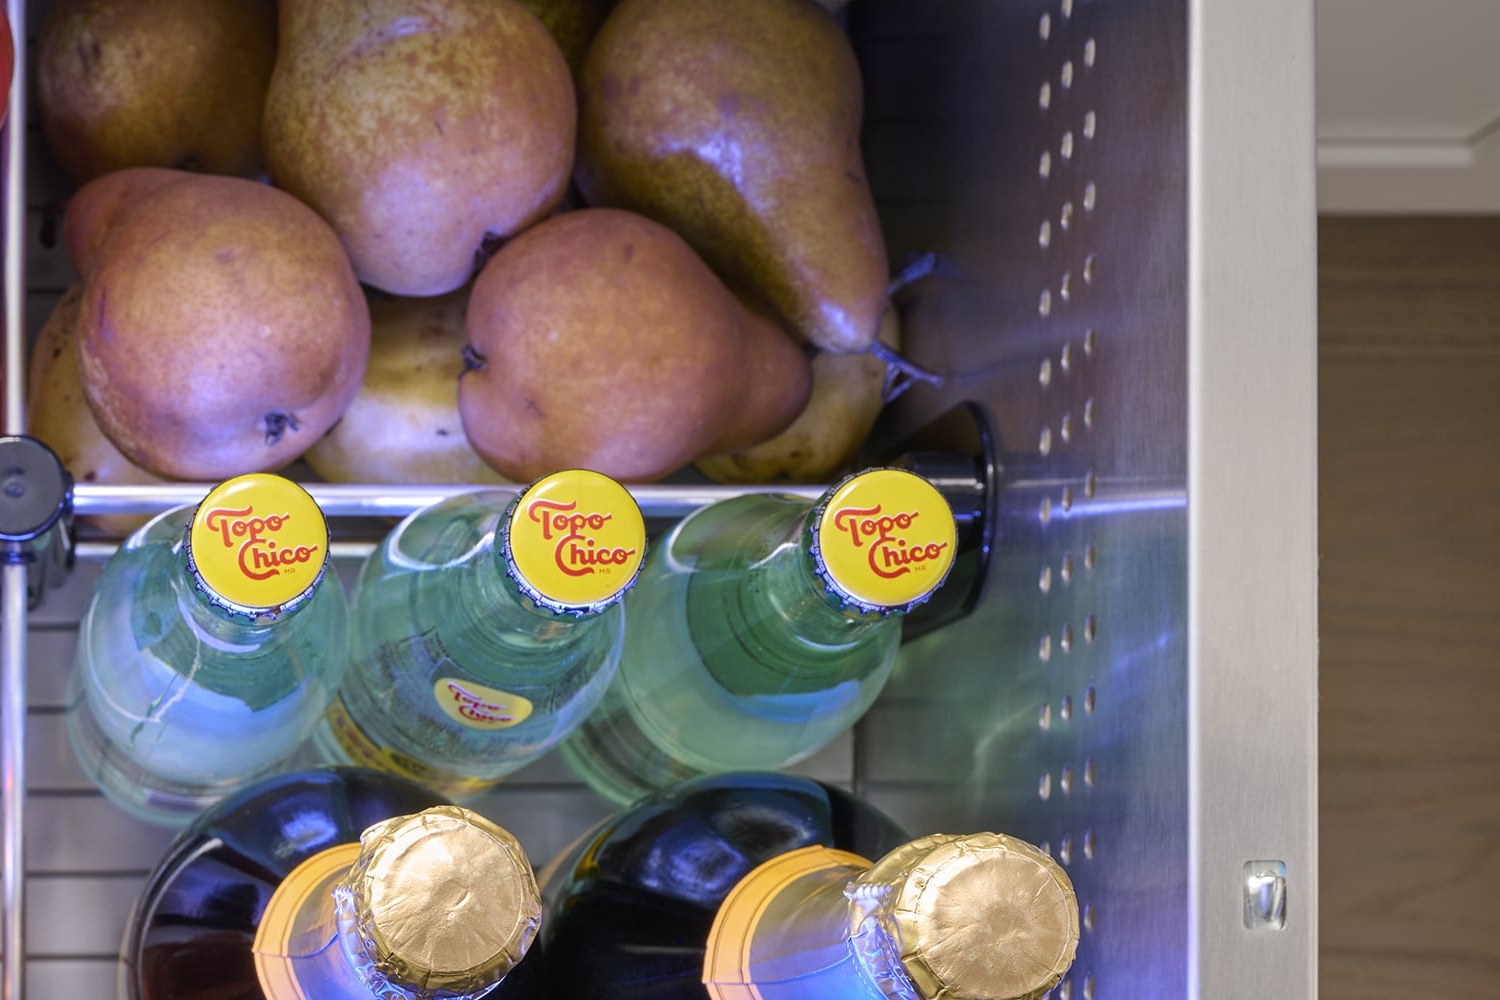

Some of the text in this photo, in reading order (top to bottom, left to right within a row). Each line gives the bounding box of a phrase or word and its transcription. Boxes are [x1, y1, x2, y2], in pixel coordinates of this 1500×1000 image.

[206, 505, 290, 548] Topo
[528, 500, 612, 540] Topo
[834, 504, 919, 547] Topo
[238, 538, 318, 580] Chico
[555, 534, 636, 577] Chico
[868, 536, 948, 579] Chico
